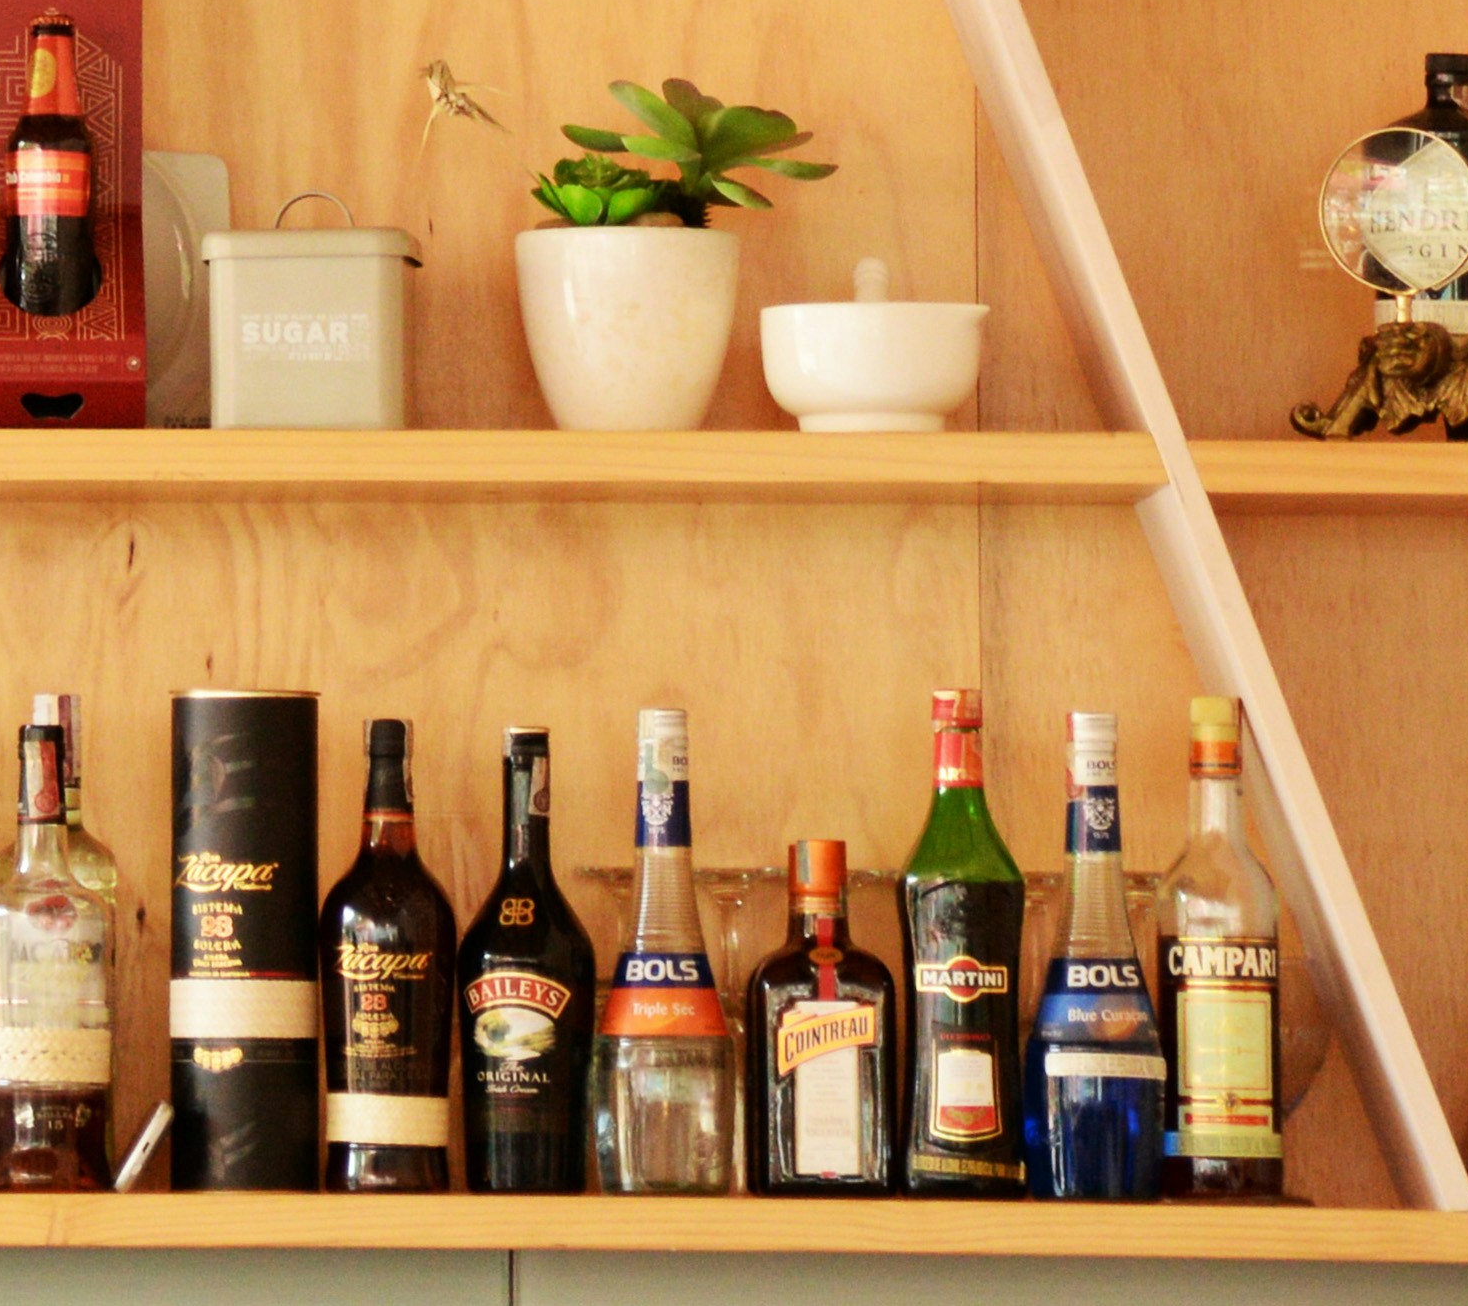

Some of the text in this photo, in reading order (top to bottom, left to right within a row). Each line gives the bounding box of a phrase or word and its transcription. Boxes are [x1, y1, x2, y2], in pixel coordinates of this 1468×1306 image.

[241, 320, 350, 345] SUGAR
[175, 853, 274, 892] Zacapa
[337, 943, 429, 981] Zacapa
[625, 959, 699, 982] BOLS
[1168, 945, 1277, 977] CAMPARI
[922, 970, 1003, 987] MARTINI
[1067, 964, 1140, 988] BOLS
[468, 977, 561, 1007] BAILEYS
[632, 1000, 696, 1018] Triple Sec
[1067, 1008, 1097, 1023] Blue
[784, 1012, 870, 1063] COINTREAU
[477, 1069, 551, 1084] ORIGINAL
